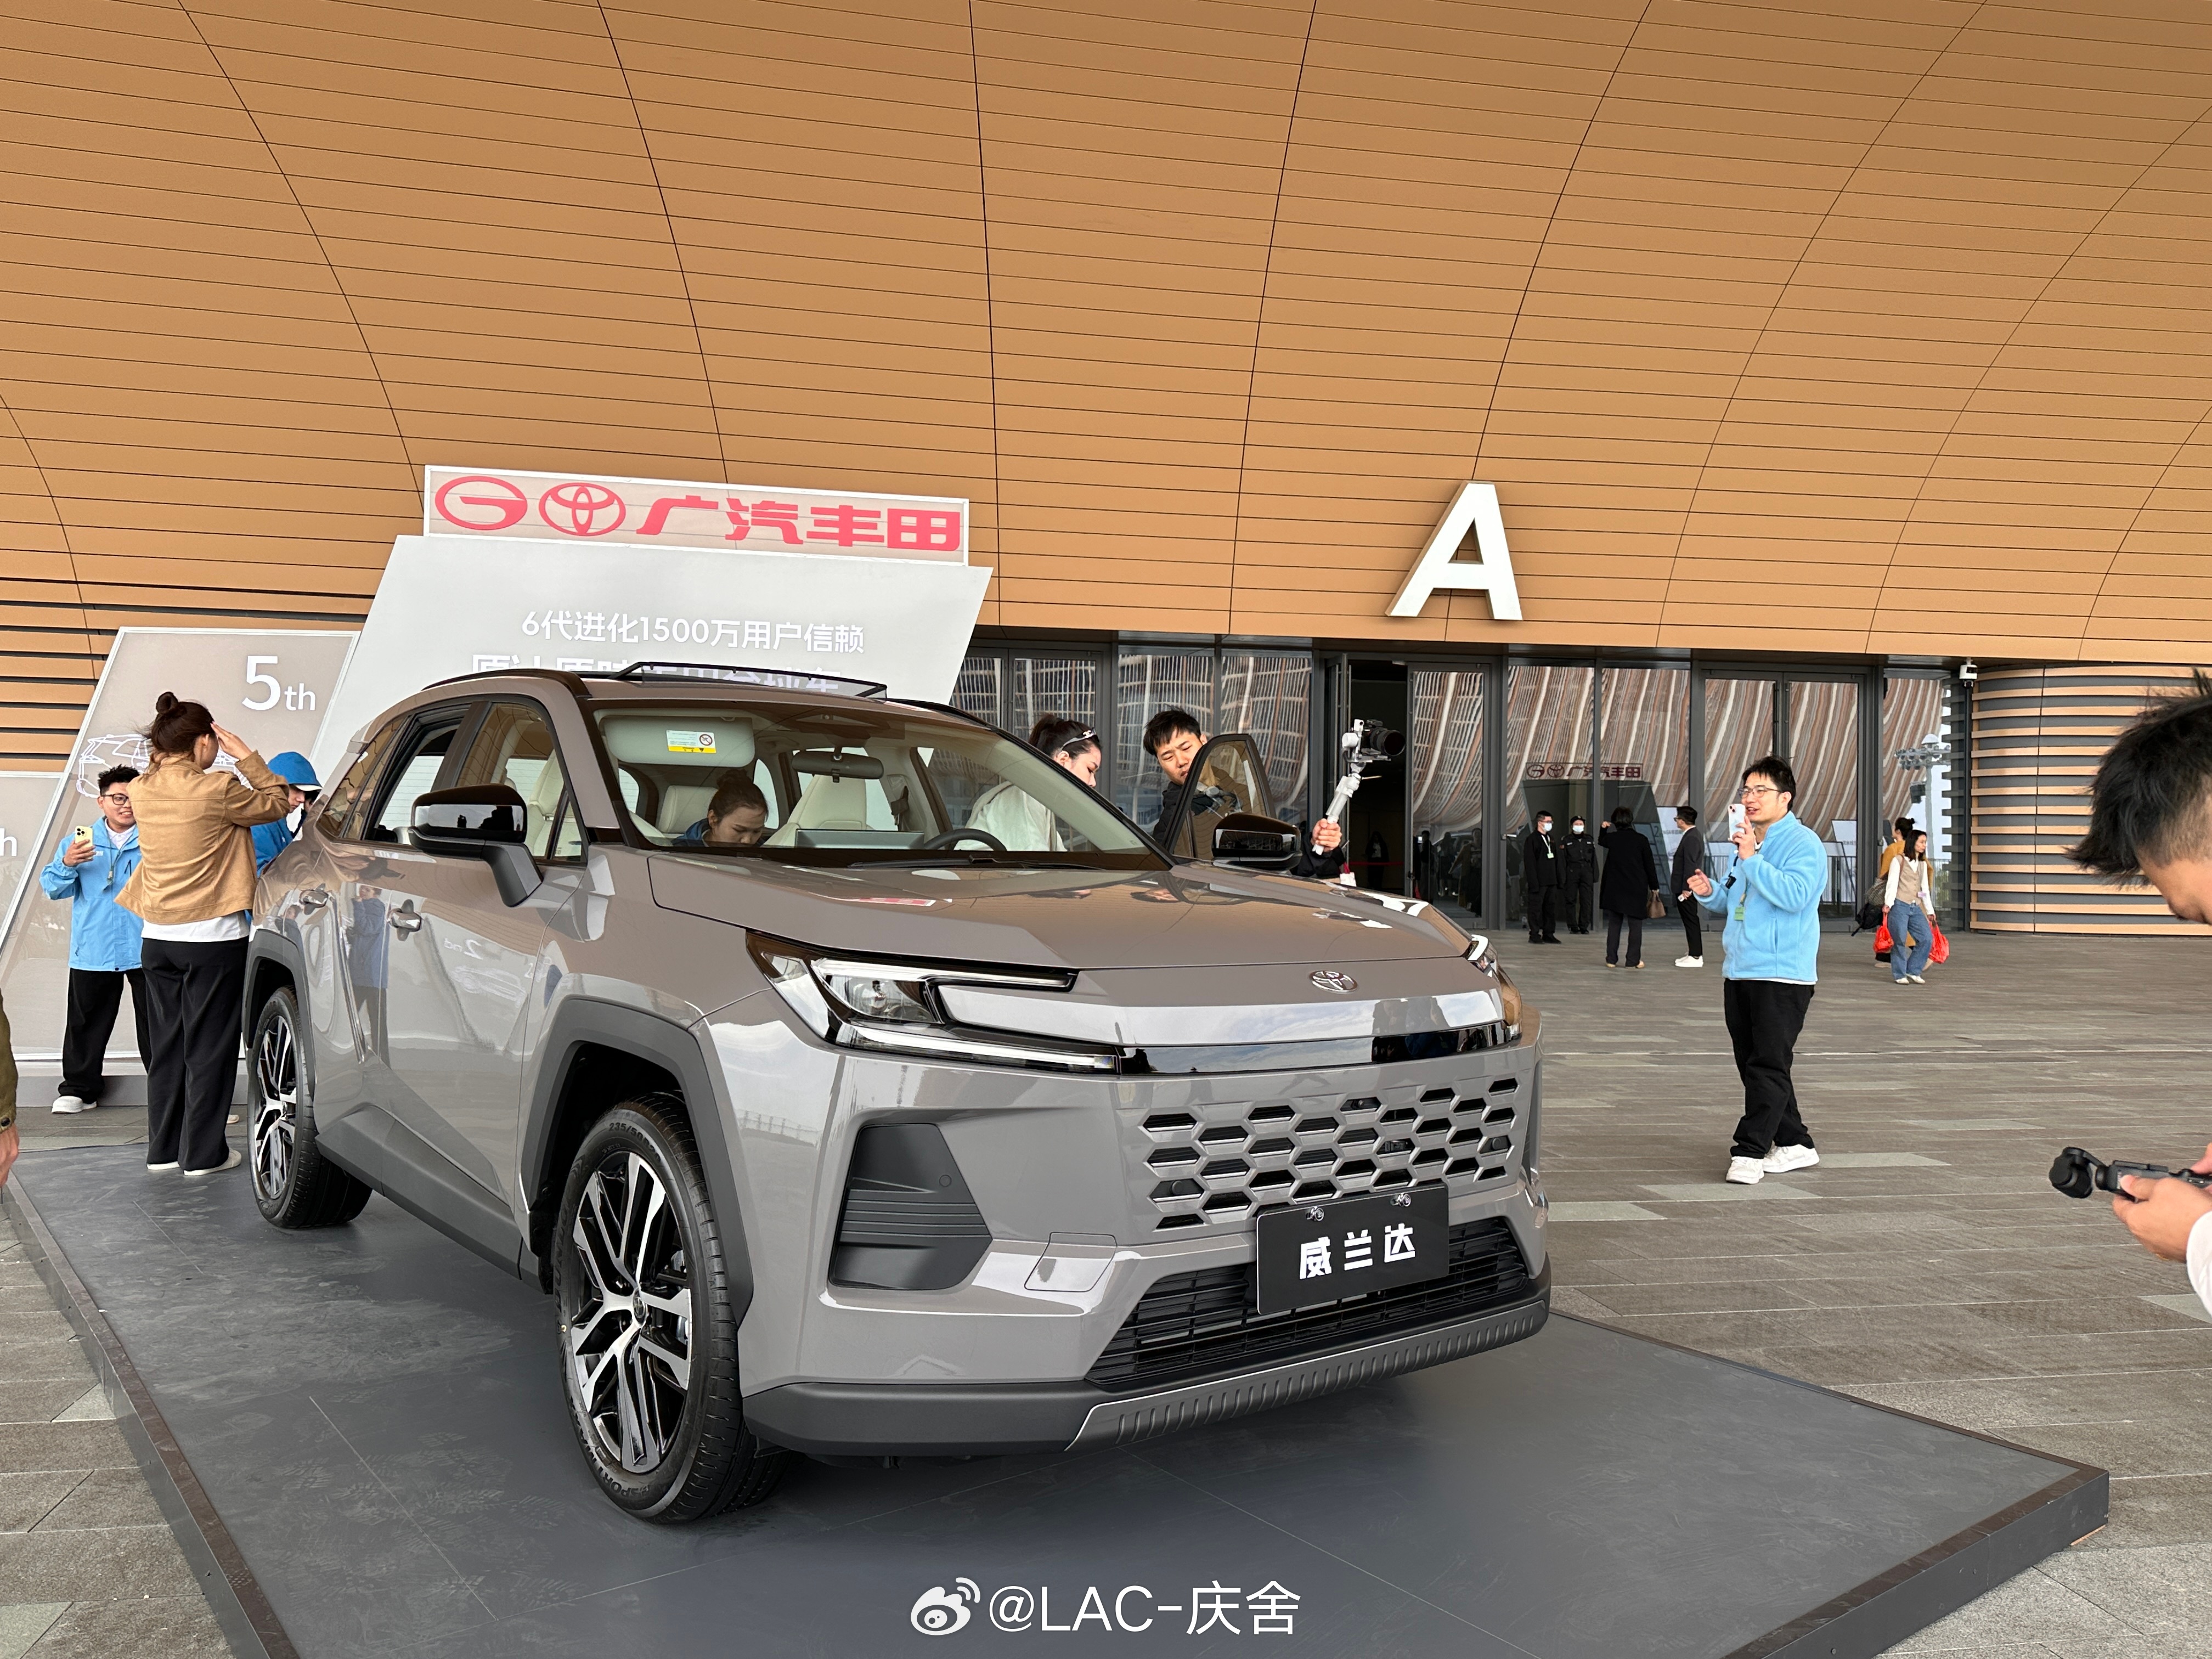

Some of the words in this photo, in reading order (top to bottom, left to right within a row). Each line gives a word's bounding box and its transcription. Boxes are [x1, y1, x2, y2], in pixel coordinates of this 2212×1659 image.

[636, 495, 960, 551] 广汽丰田
[1390, 483, 1523, 620] A
[522, 610, 864, 654] 6代进化1500万用户信赖
[242, 656, 315, 710] 5th
[1300, 1223, 1415, 1279] 威兰达
